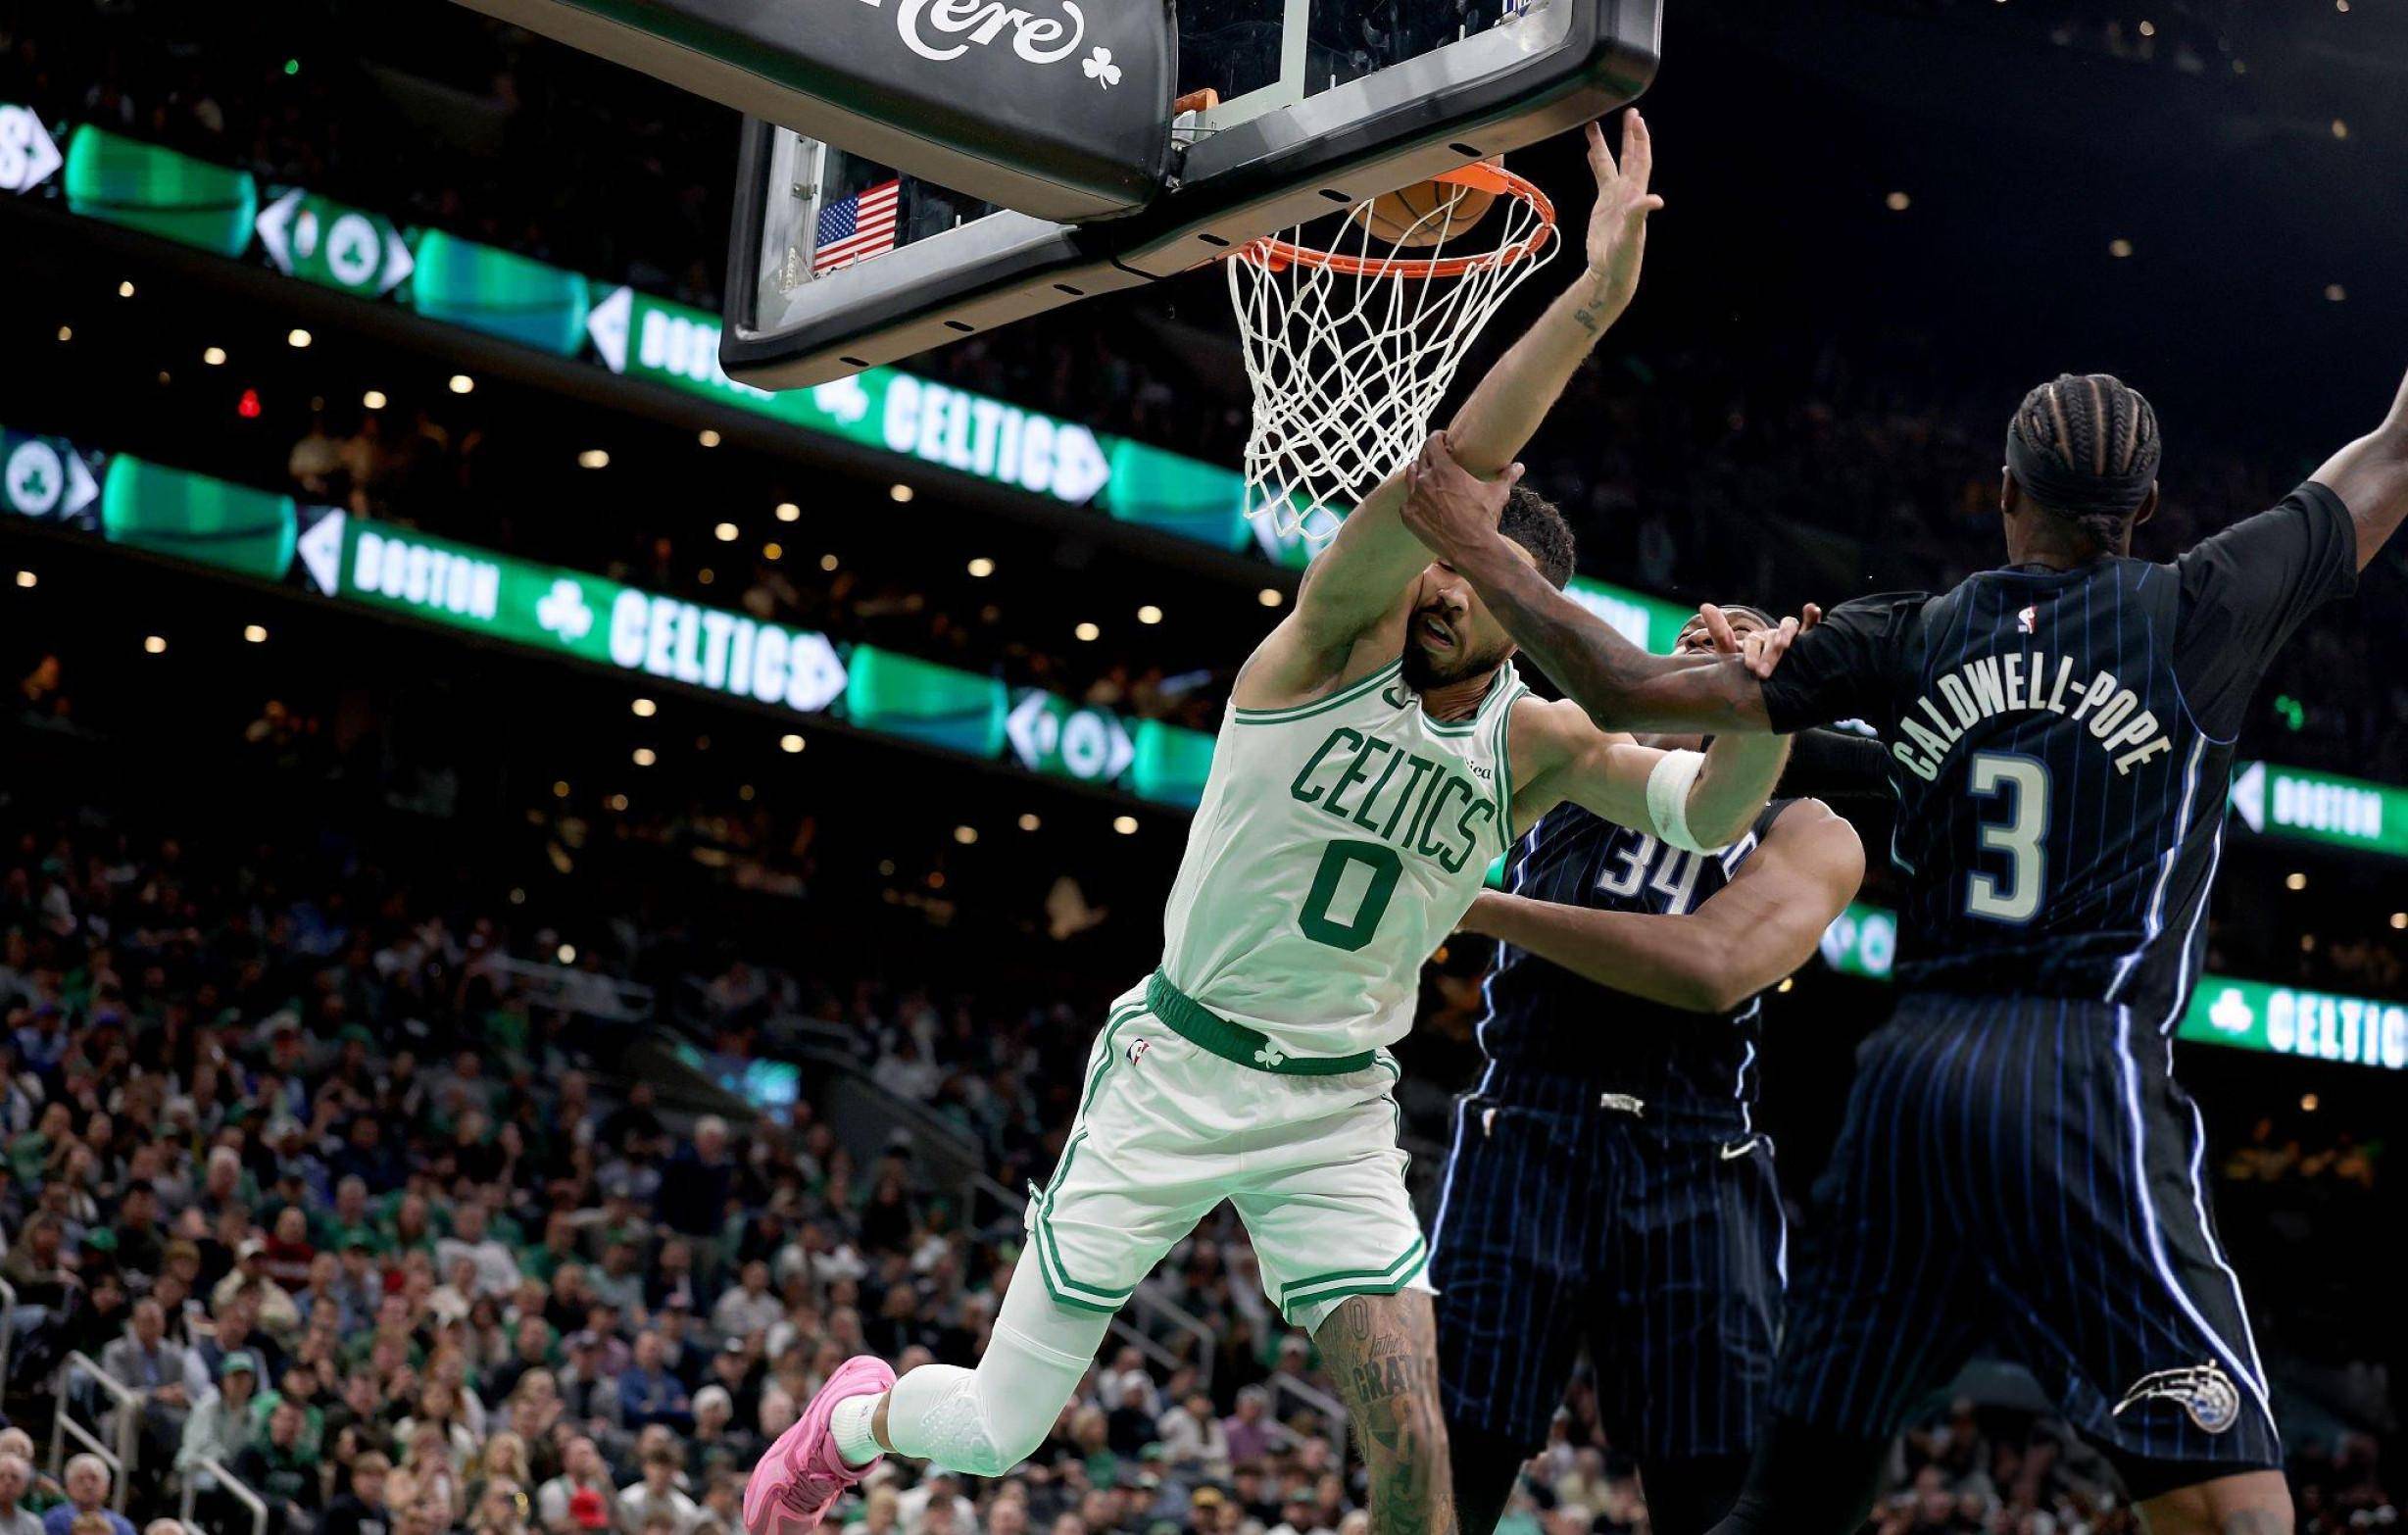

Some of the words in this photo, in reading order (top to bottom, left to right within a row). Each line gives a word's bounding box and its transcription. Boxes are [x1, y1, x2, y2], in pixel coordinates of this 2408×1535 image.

[354, 532, 499, 619] BOSTON
[610, 589, 821, 712] CELTICS
[1892, 651, 2173, 782] CALDWELL-POPE
[1290, 726, 1496, 874] CELTICS
[1968, 751, 2050, 923] 3
[1298, 839, 1403, 952] 0
[1596, 826, 1704, 916] 34
[2266, 988, 2408, 1069] CELTIC
